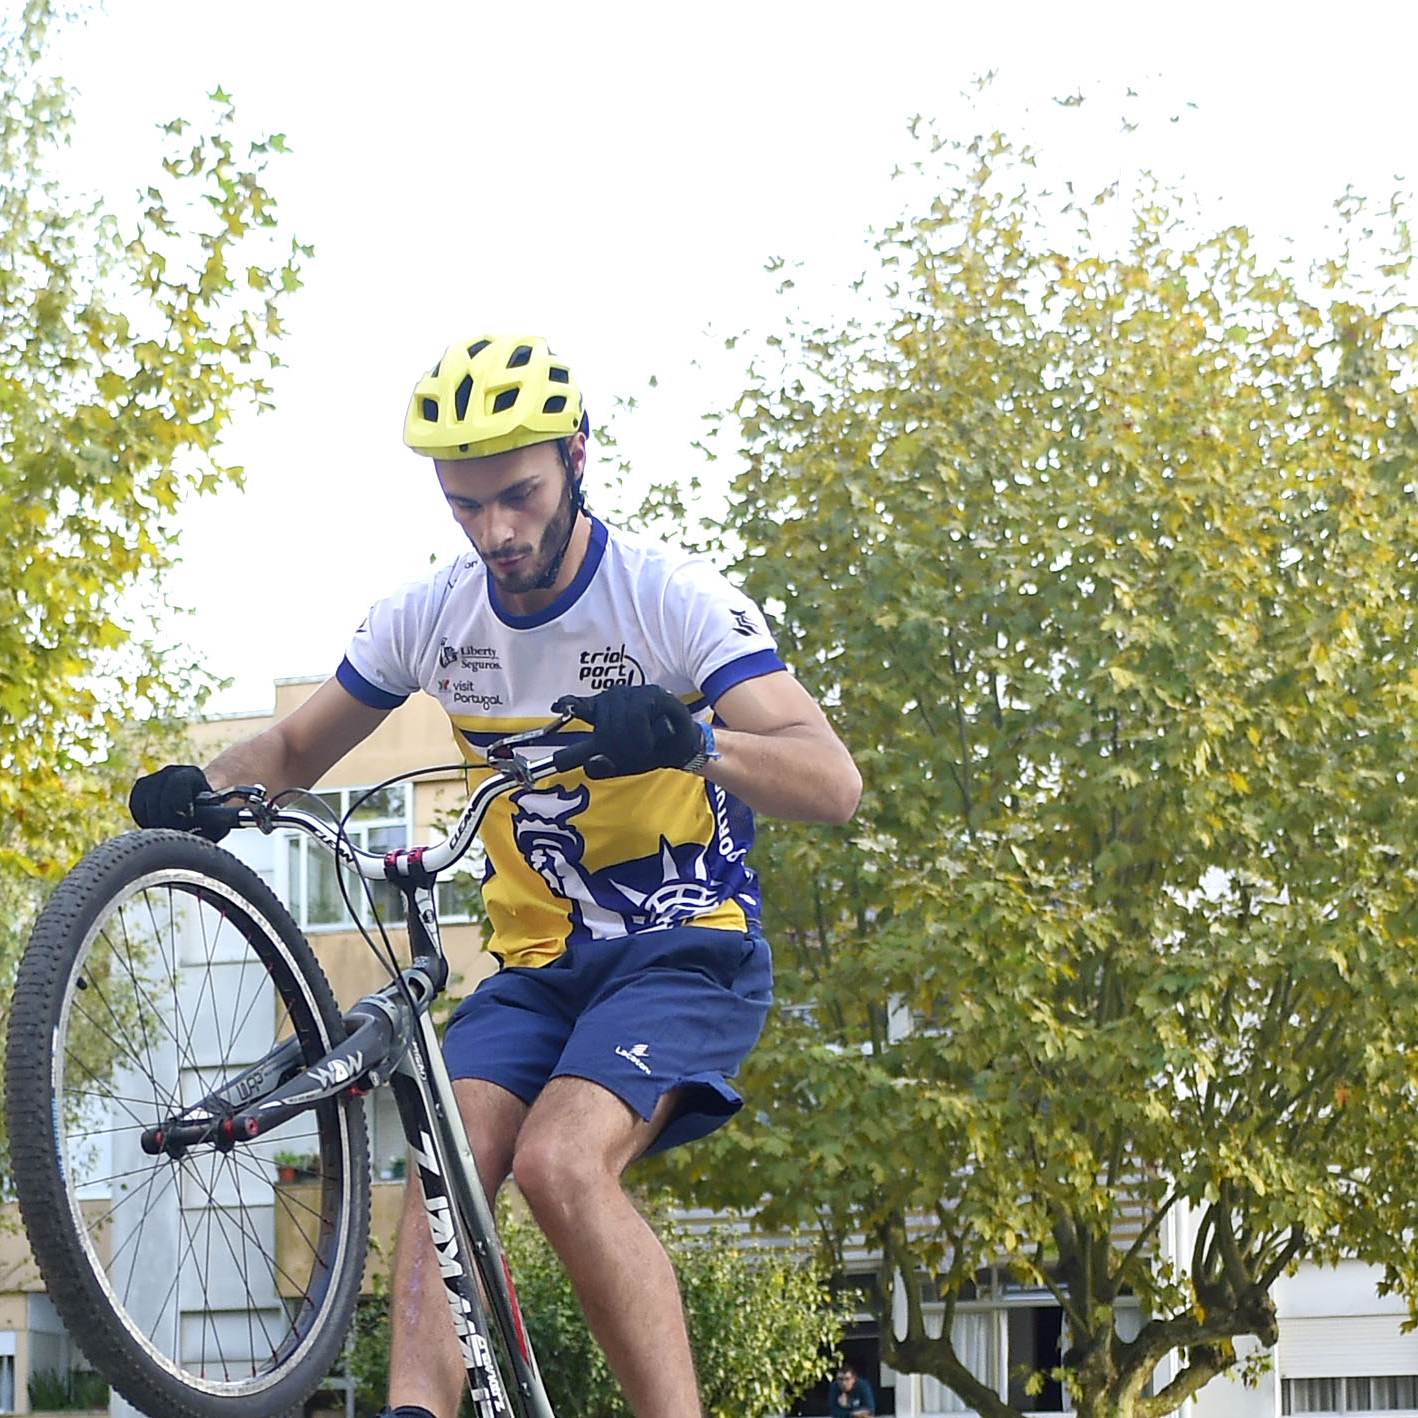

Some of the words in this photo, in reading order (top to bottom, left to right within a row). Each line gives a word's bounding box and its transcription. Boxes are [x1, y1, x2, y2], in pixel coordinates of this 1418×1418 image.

[460, 646, 497, 659] Liberty
[580, 643, 625, 664] trial
[579, 664, 626, 681] port
[453, 681, 474, 692] visit
[454, 692, 503, 710] Portugal
[449, 803, 477, 850] CLEAN
